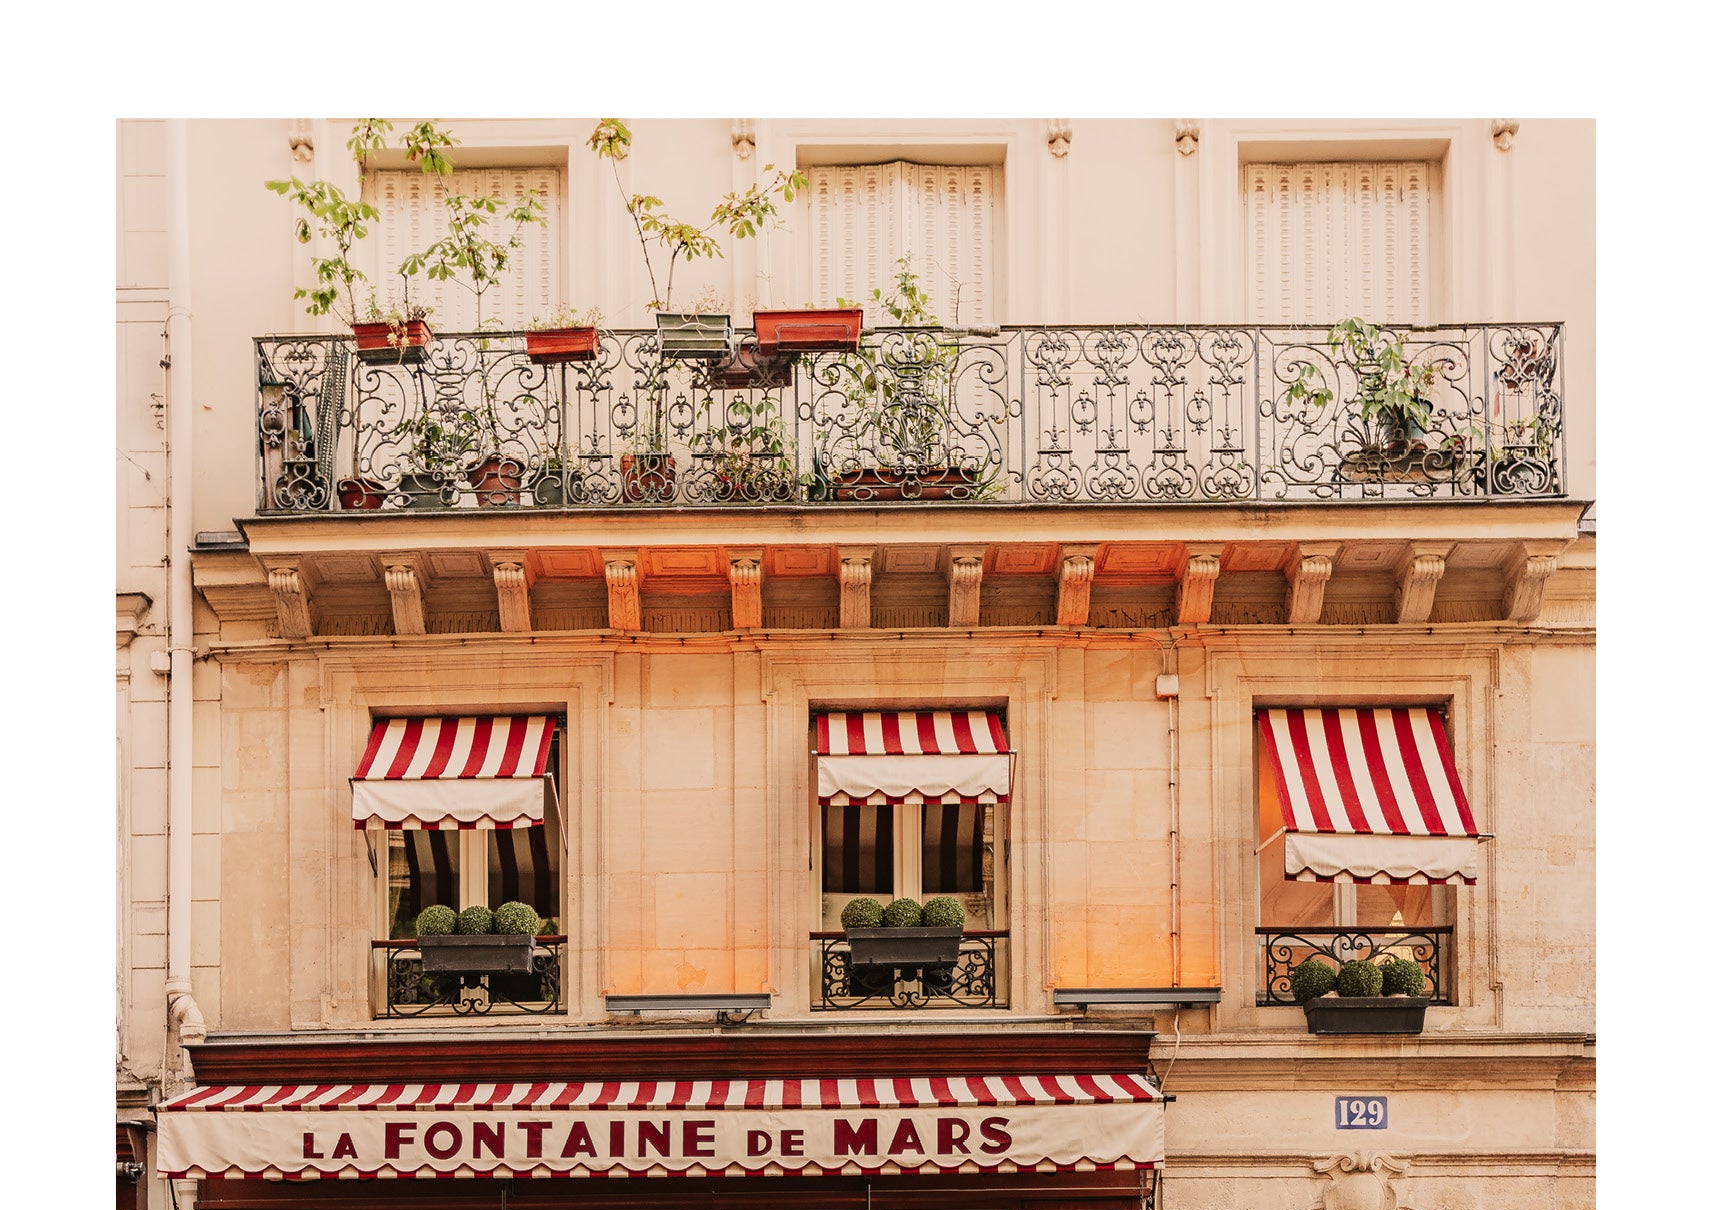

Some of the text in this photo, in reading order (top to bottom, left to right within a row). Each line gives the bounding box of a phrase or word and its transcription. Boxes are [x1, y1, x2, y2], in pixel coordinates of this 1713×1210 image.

[1339, 1100, 1384, 1126] 129
[302, 1116, 1014, 1161] LA FONTAINE DE MARS
